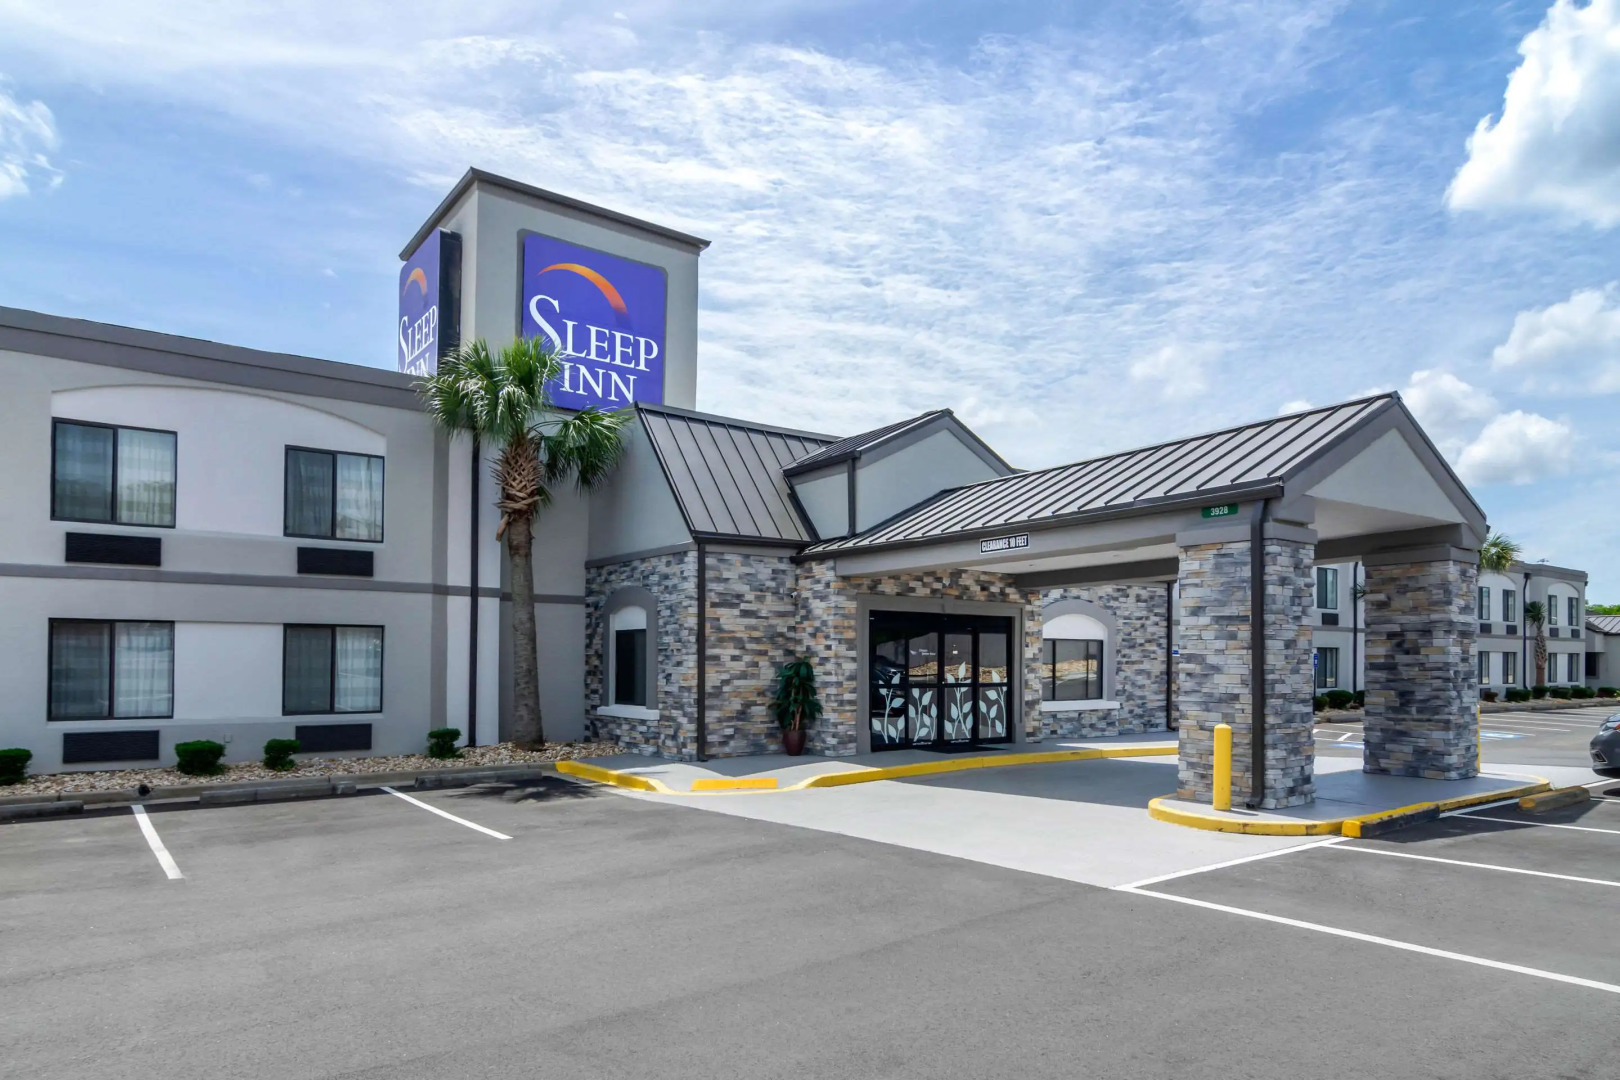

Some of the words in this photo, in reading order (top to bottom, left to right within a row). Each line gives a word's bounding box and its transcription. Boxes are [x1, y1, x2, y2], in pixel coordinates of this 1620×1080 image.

[400, 305, 437, 374] SLEEP
[529, 294, 659, 372] SLEEP
[560, 361, 637, 404] INN
[1210, 505, 1229, 516] 3928
[1016, 535, 1028, 547] FEET
